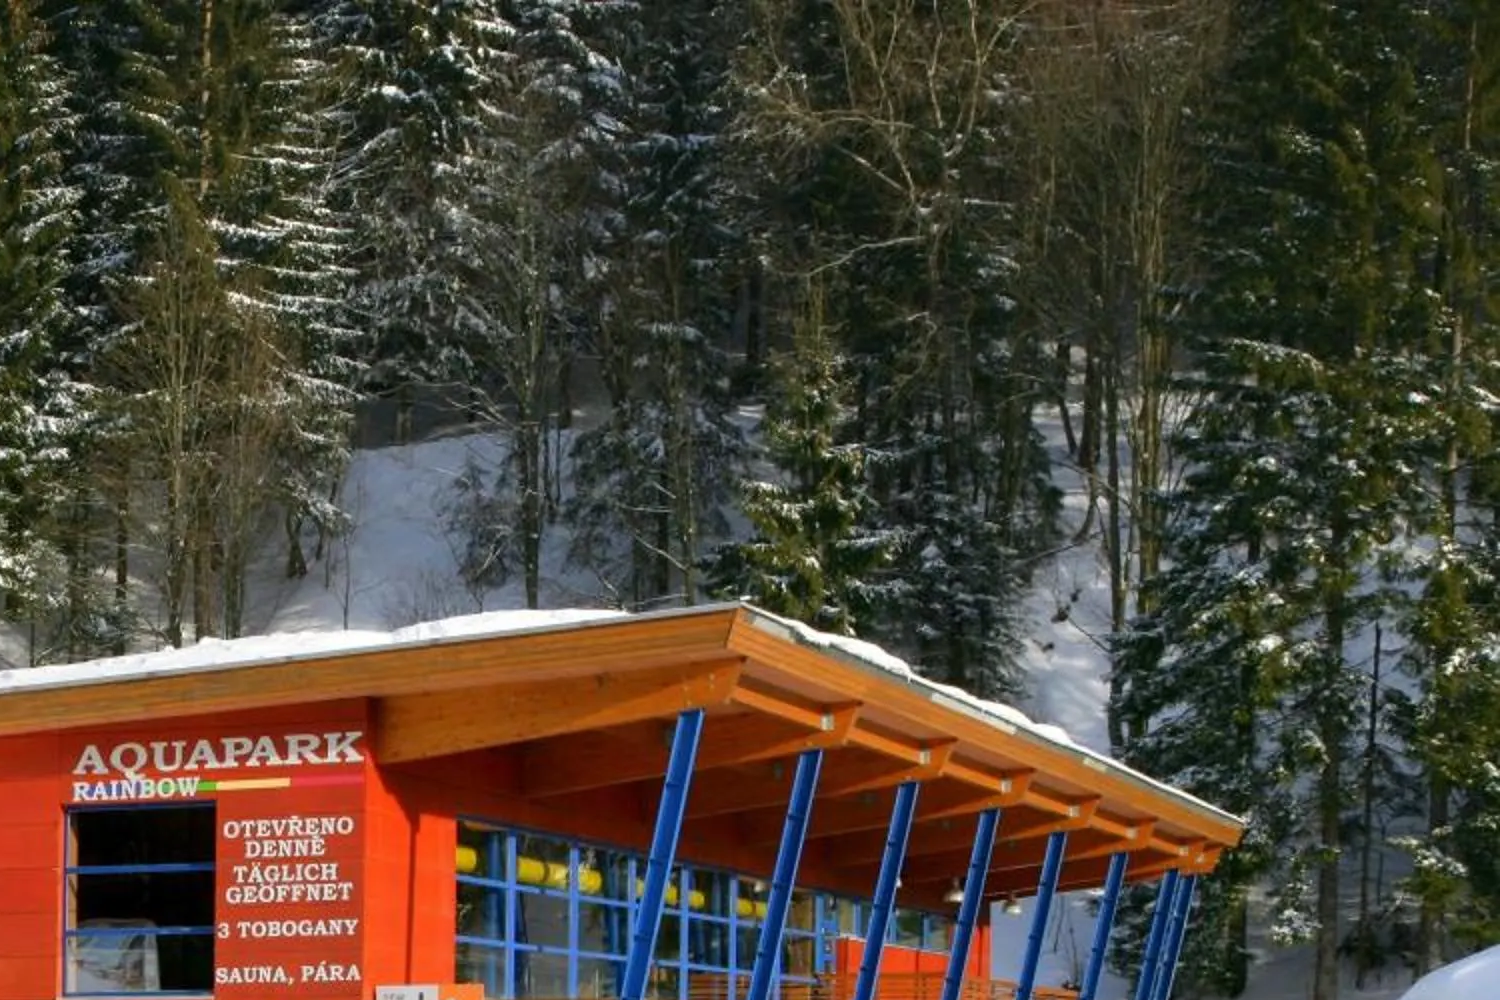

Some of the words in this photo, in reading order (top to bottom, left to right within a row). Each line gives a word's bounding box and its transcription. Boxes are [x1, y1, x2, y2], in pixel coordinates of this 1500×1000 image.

[72, 731, 365, 780] AQUAPARK
[72, 776, 200, 801] RAINBOW
[223, 816, 354, 838] OTEVŘENO
[245, 835, 326, 858] DENNĚ
[233, 862, 338, 883] TÄGLICH
[225, 882, 353, 904] GEÖFFNET
[217, 922, 230, 938] 3
[237, 919, 358, 938] TOBOGANY
[215, 966, 295, 986] SAUNA,
[300, 960, 361, 982] PÁRA
